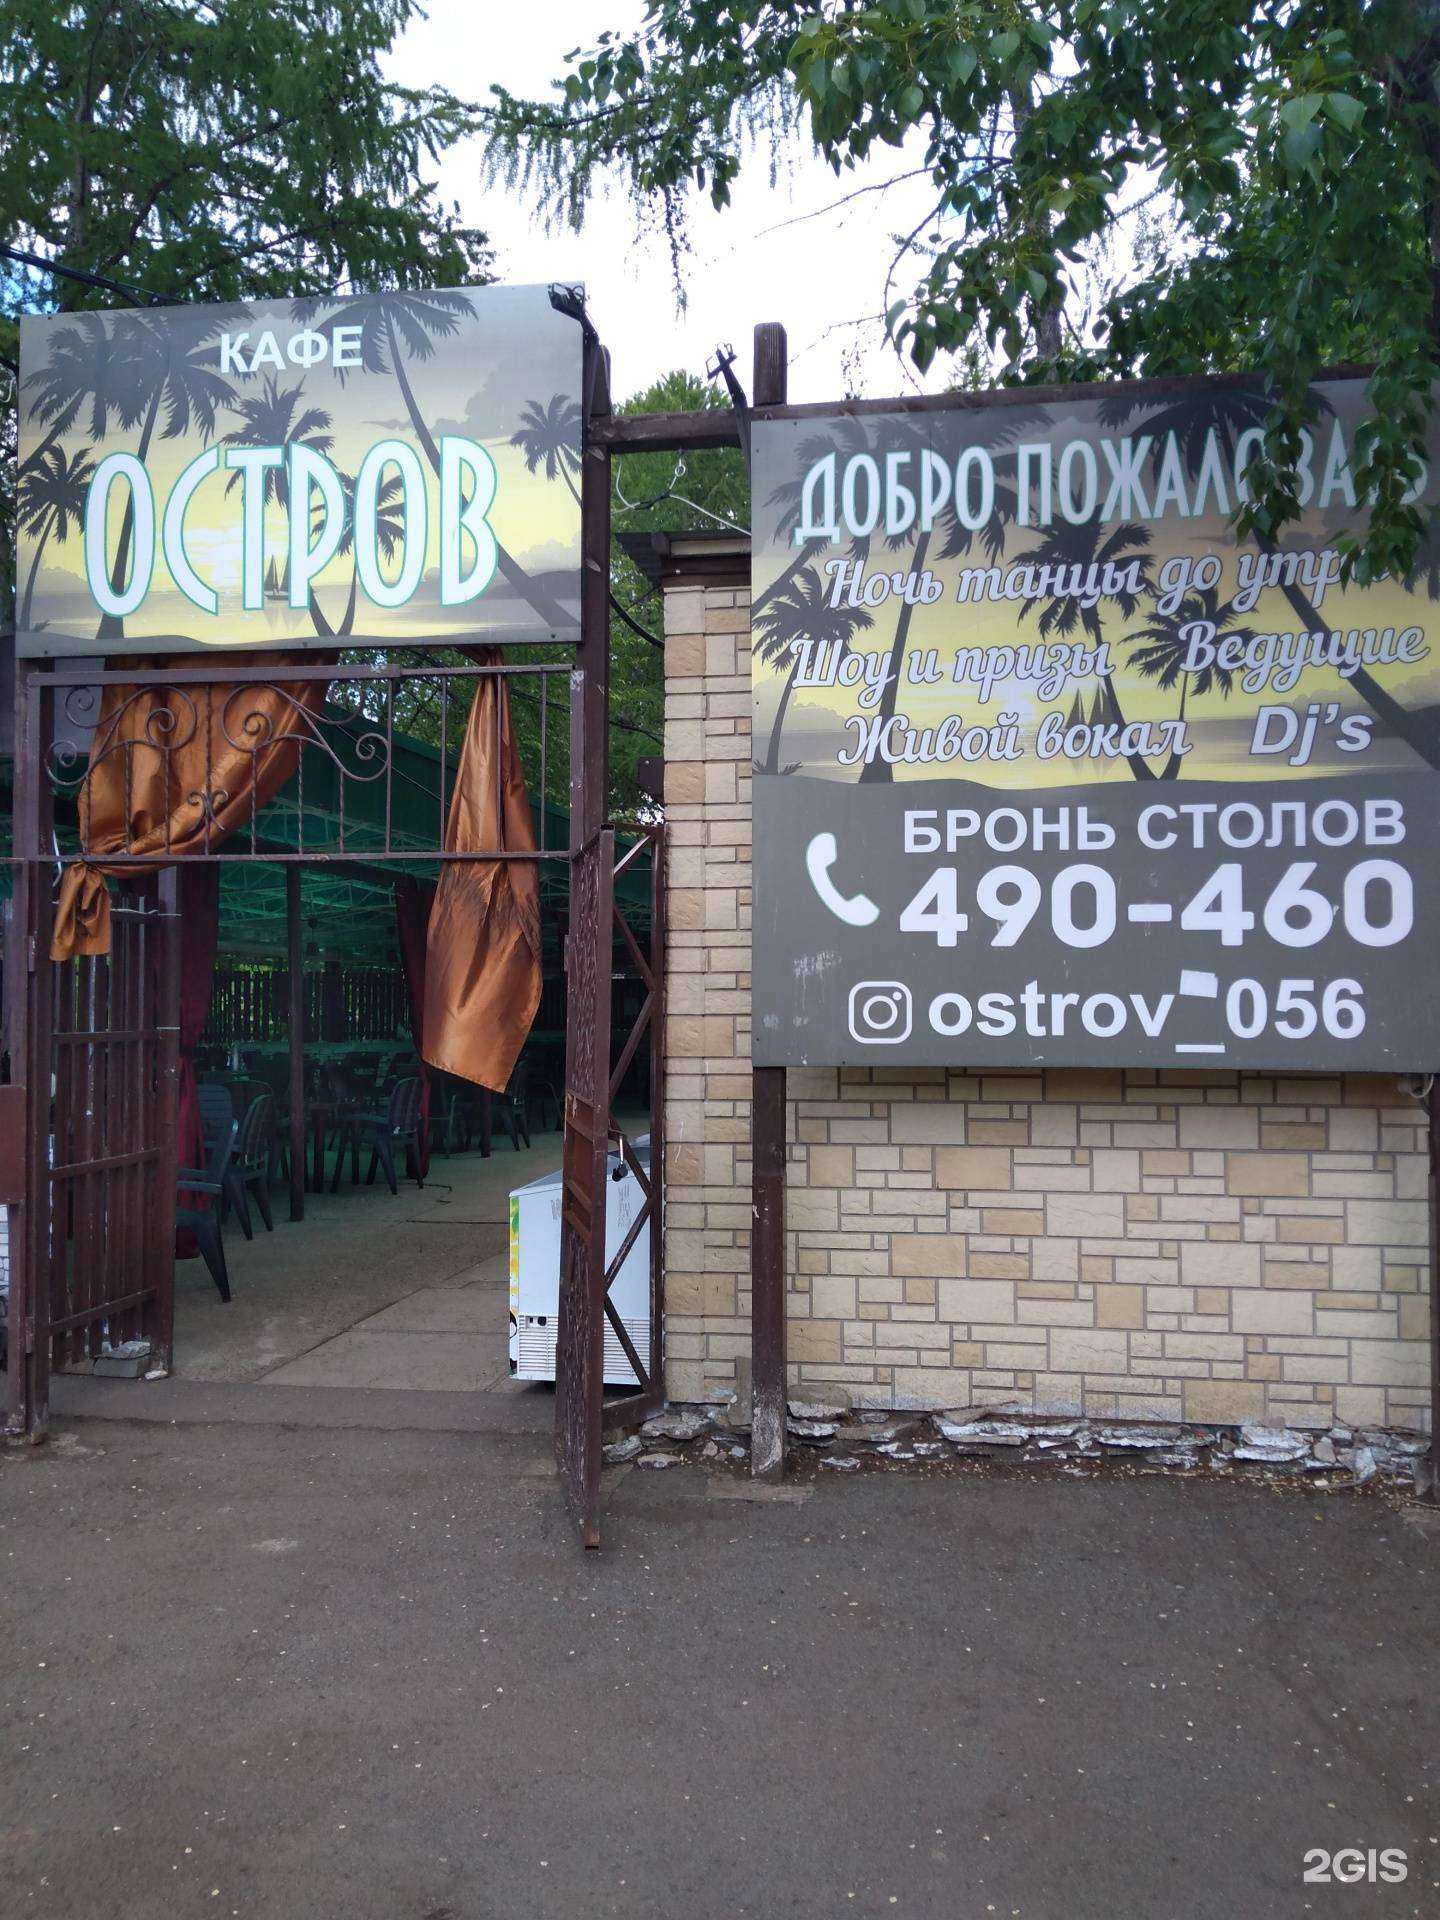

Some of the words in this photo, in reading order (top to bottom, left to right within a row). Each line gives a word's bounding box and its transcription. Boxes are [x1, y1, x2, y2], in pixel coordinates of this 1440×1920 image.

[220, 325, 364, 373] КАФЕ
[83, 434, 498, 618] ОСТРОВ
[795, 444, 996, 546] ДОБРО
[825, 556, 944, 609] Ночь
[958, 560, 1146, 608] танцы
[1158, 554, 1223, 615] до
[790, 638, 895, 708] Шоу
[907, 650, 943, 684] и
[952, 640, 1116, 703] призы
[1178, 622, 1430, 693] Ведущие
[837, 712, 1024, 766] Живой
[1036, 710, 1194, 760] вокал
[904, 807, 1116, 854] БРОНЬ
[1137, 800, 1406, 848] СТОЛОВ
[899, 858, 1414, 949] 490-460
